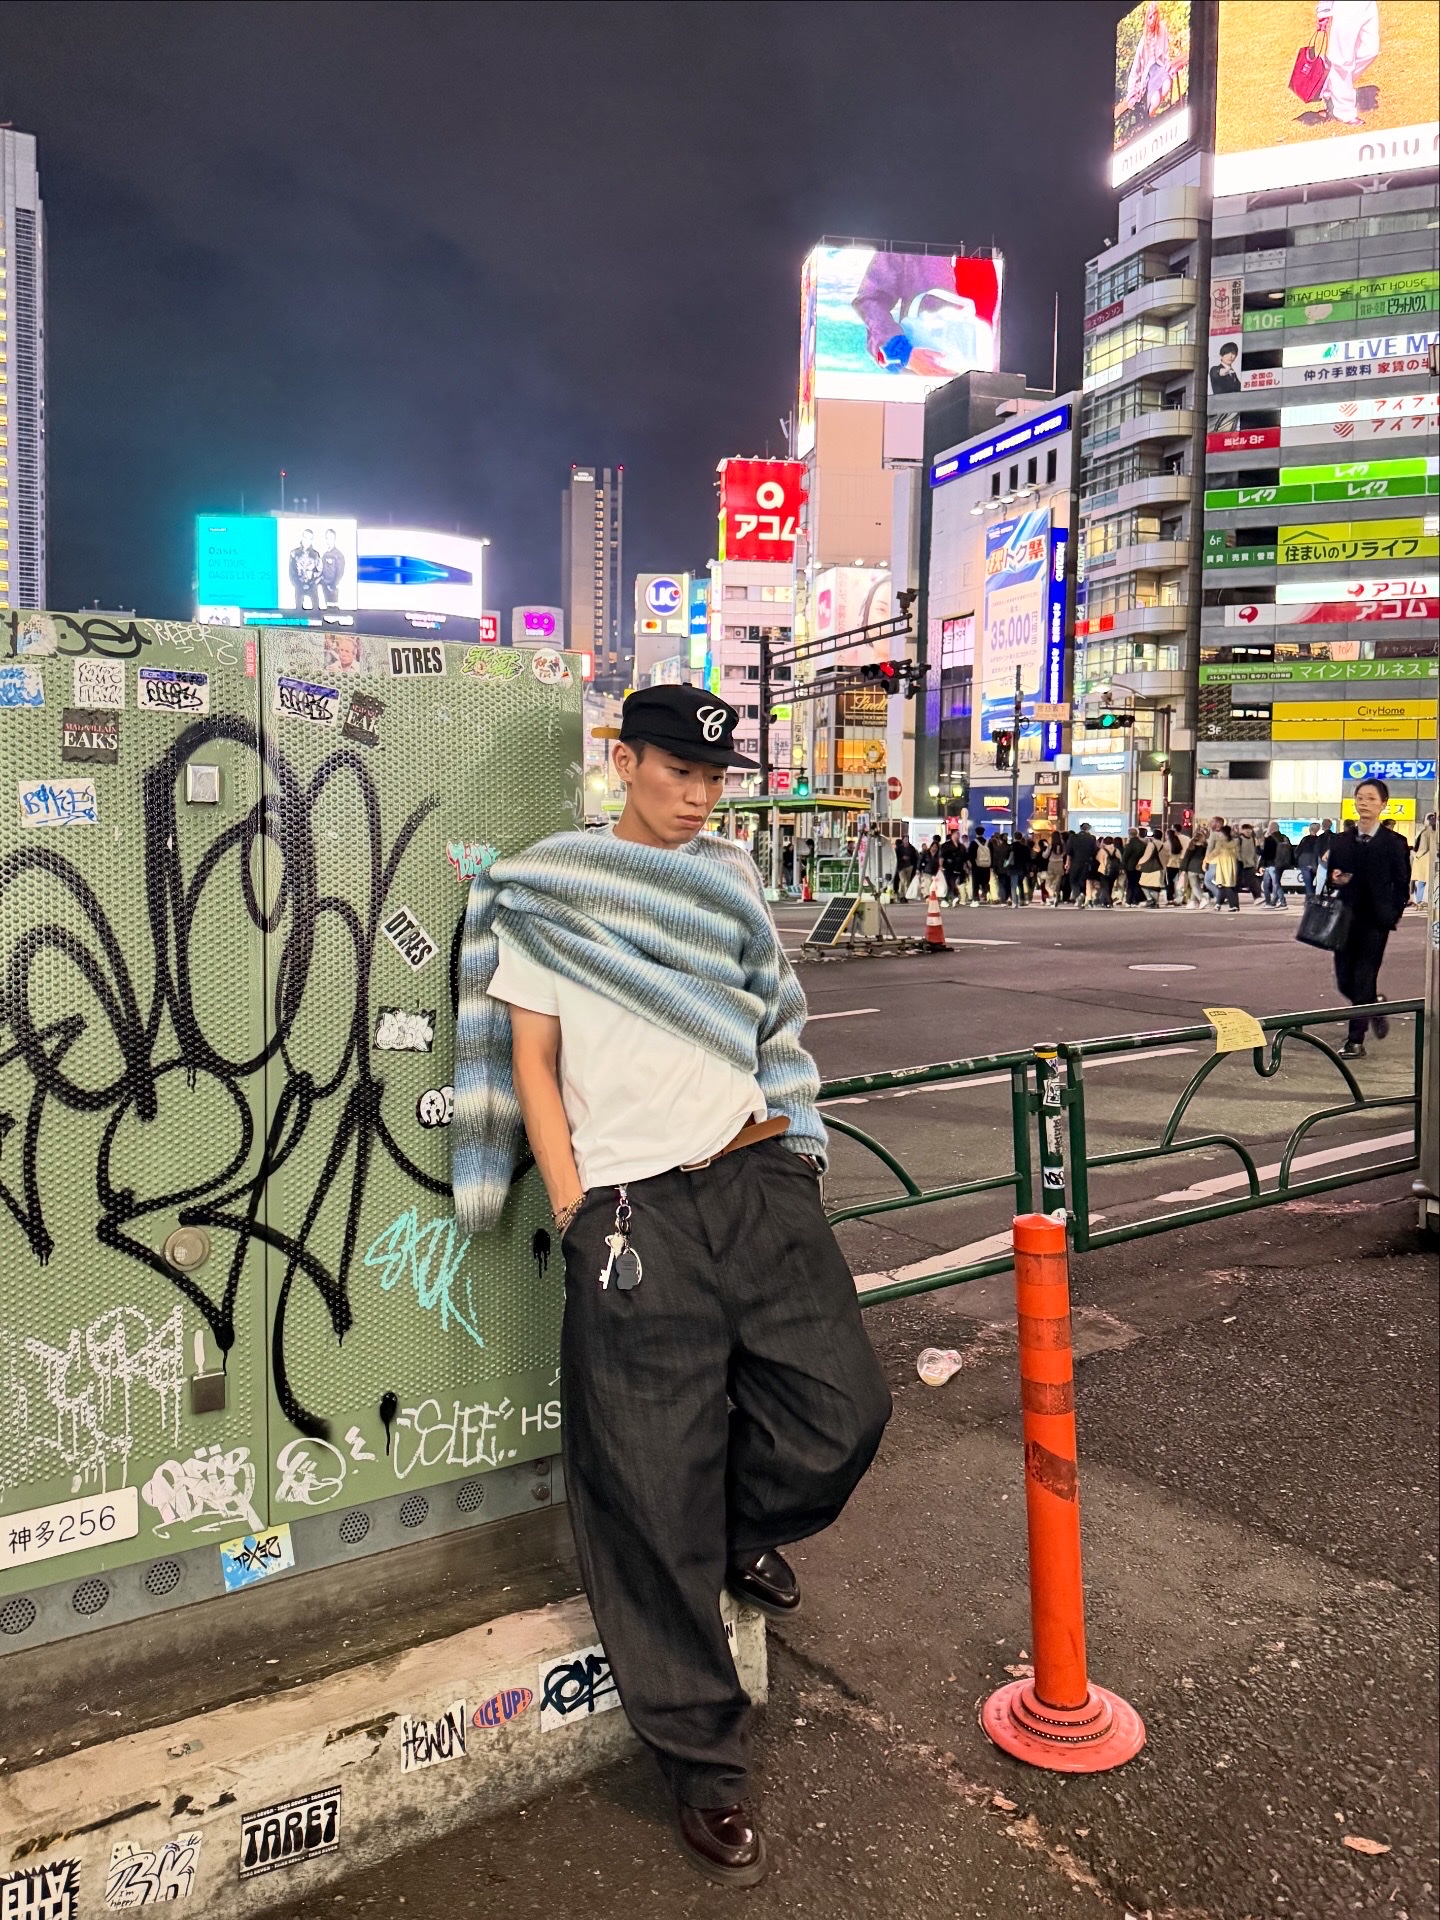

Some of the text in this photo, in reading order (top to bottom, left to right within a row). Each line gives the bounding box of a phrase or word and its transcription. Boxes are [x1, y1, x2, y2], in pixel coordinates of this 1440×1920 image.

[1359, 137, 1420, 162] miu
[1287, 287, 1353, 302] PITAT HOUSE
[1359, 278, 1427, 294] PITAT HOUSE
[1251, 372, 1274, 381] 全国の
[1304, 363, 1371, 381] 仲介手数料
[1335, 464, 1370, 478] レイク
[1238, 488, 1277, 504] レイク
[1348, 481, 1388, 496] レイク
[1209, 535, 1222, 546] 6F
[1285, 539, 1419, 562] 住まいのリライフ
[1372, 581, 1427, 597] アコム
[1355, 599, 1428, 620] アコム
[391, 646, 443, 675] DTRES
[1299, 662, 1422, 679] マインドフルネス
[1357, 706, 1406, 716] CityHome
[1207, 724, 1222, 735] 3F
[63, 730, 118, 750] EAKS
[384, 910, 433, 967] DTRES
[8, 1505, 116, 1554] 神多256
[480, 1690, 528, 1727] ICE UP!
[244, 1799, 338, 1868] TARE7
